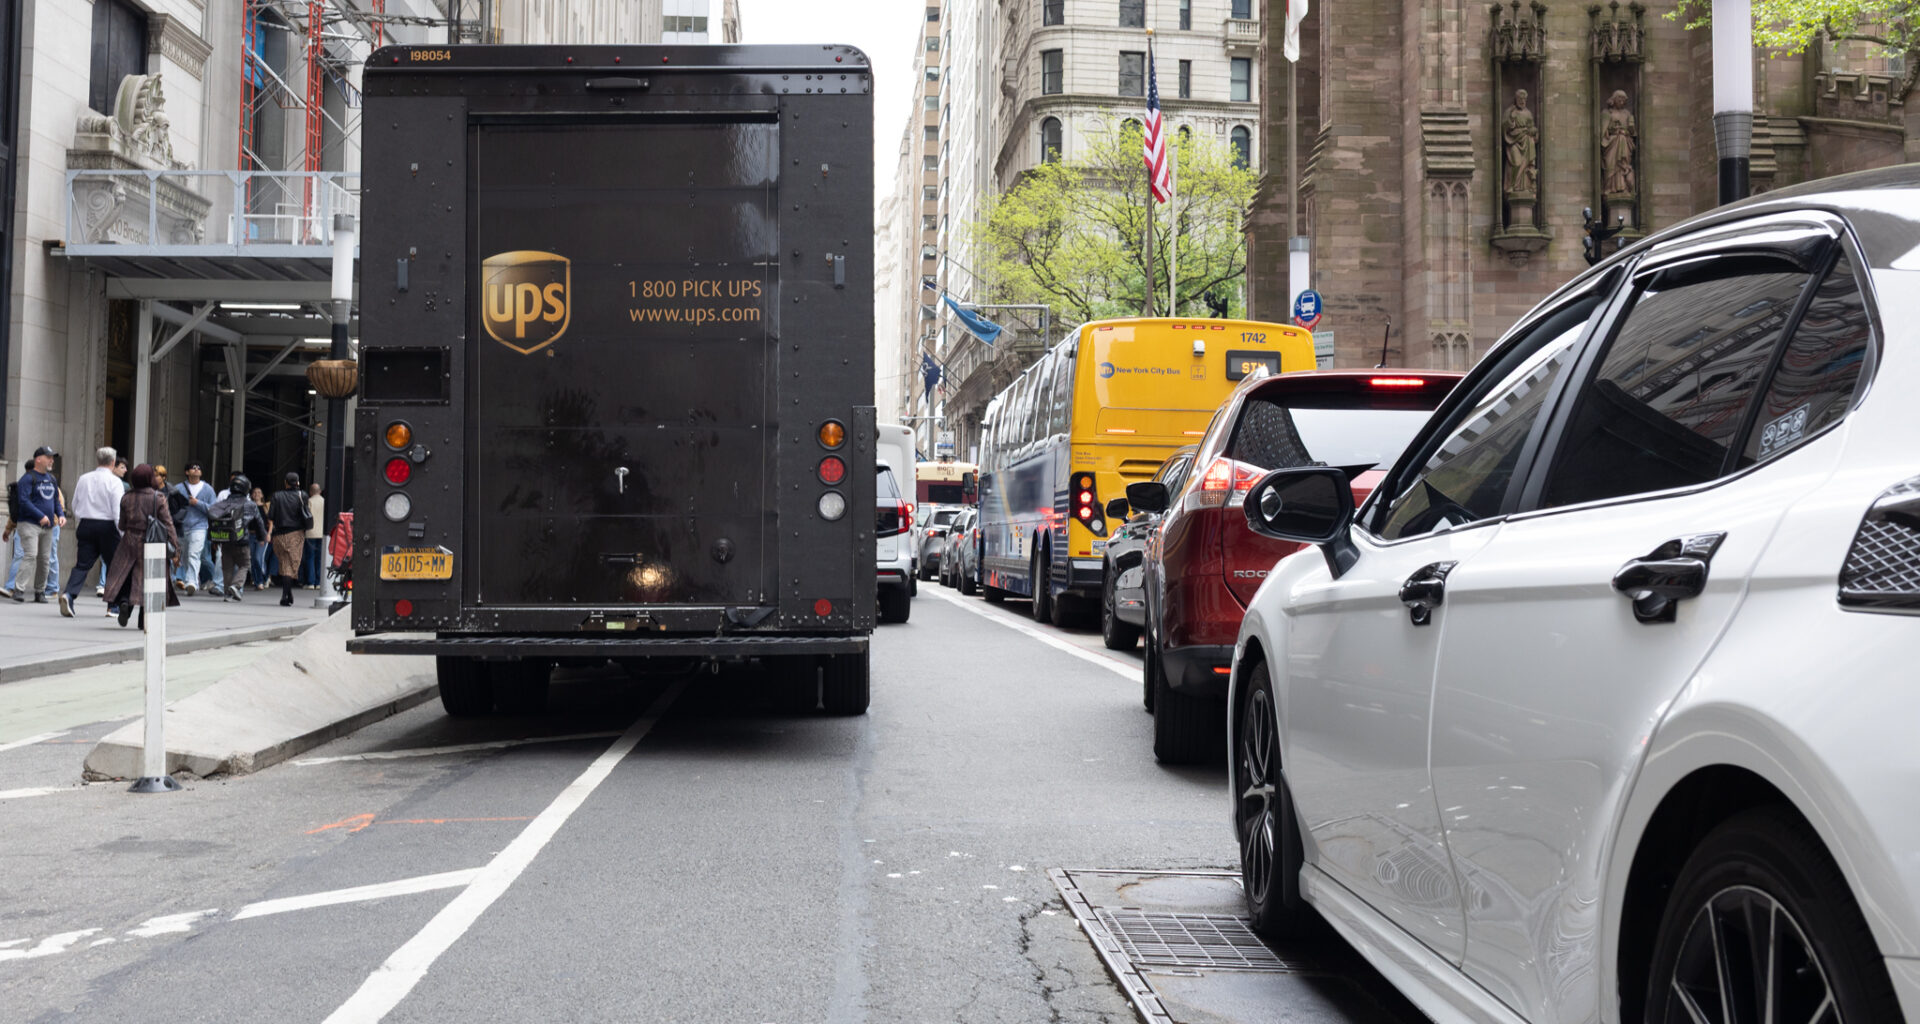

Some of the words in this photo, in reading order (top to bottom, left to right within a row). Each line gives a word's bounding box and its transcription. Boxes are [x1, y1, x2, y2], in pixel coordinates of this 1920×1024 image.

[628, 280, 636, 298] 1
[642, 280, 677, 298] 800
[682, 280, 722, 298] PICK
[728, 280, 762, 298] UPS
[488, 282, 565, 338] ups
[629, 306, 761, 326] www.ups.com
[1240, 332, 1267, 344] 1742
[1150, 367, 1165, 375] City
[1233, 570, 1271, 578] ROG
